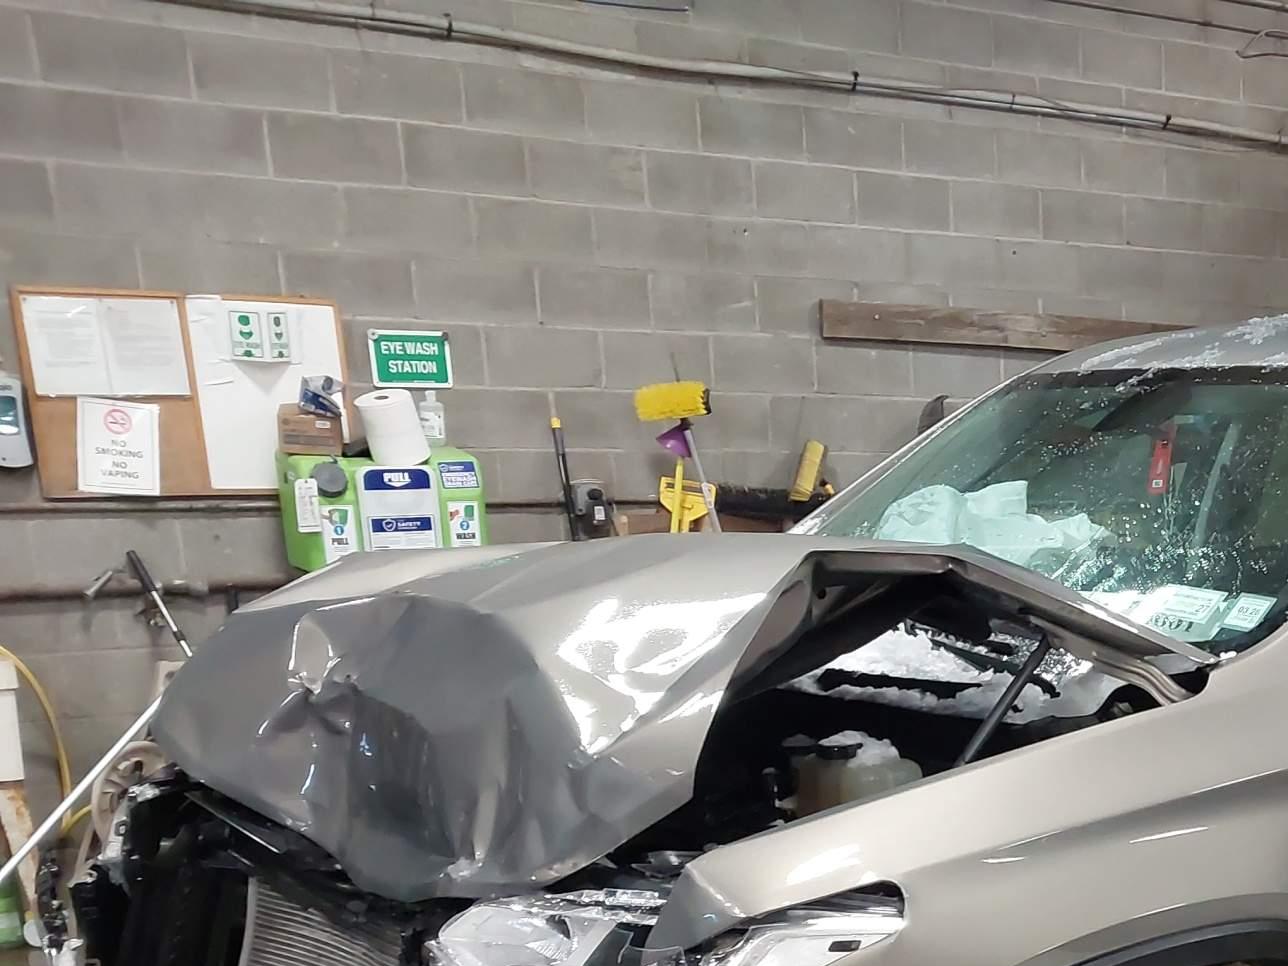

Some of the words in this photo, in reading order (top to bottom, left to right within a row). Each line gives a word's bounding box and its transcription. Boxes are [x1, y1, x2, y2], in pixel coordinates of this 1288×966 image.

[380, 341, 404, 354] EYE
[404, 342, 439, 355] WASH
[388, 360, 438, 373] STATION
[111, 439, 127, 448] NO
[95, 446, 144, 459] SMOKING
[111, 460, 128, 469] NO
[100, 469, 140, 479] VAPING
[383, 472, 411, 482] PULL
